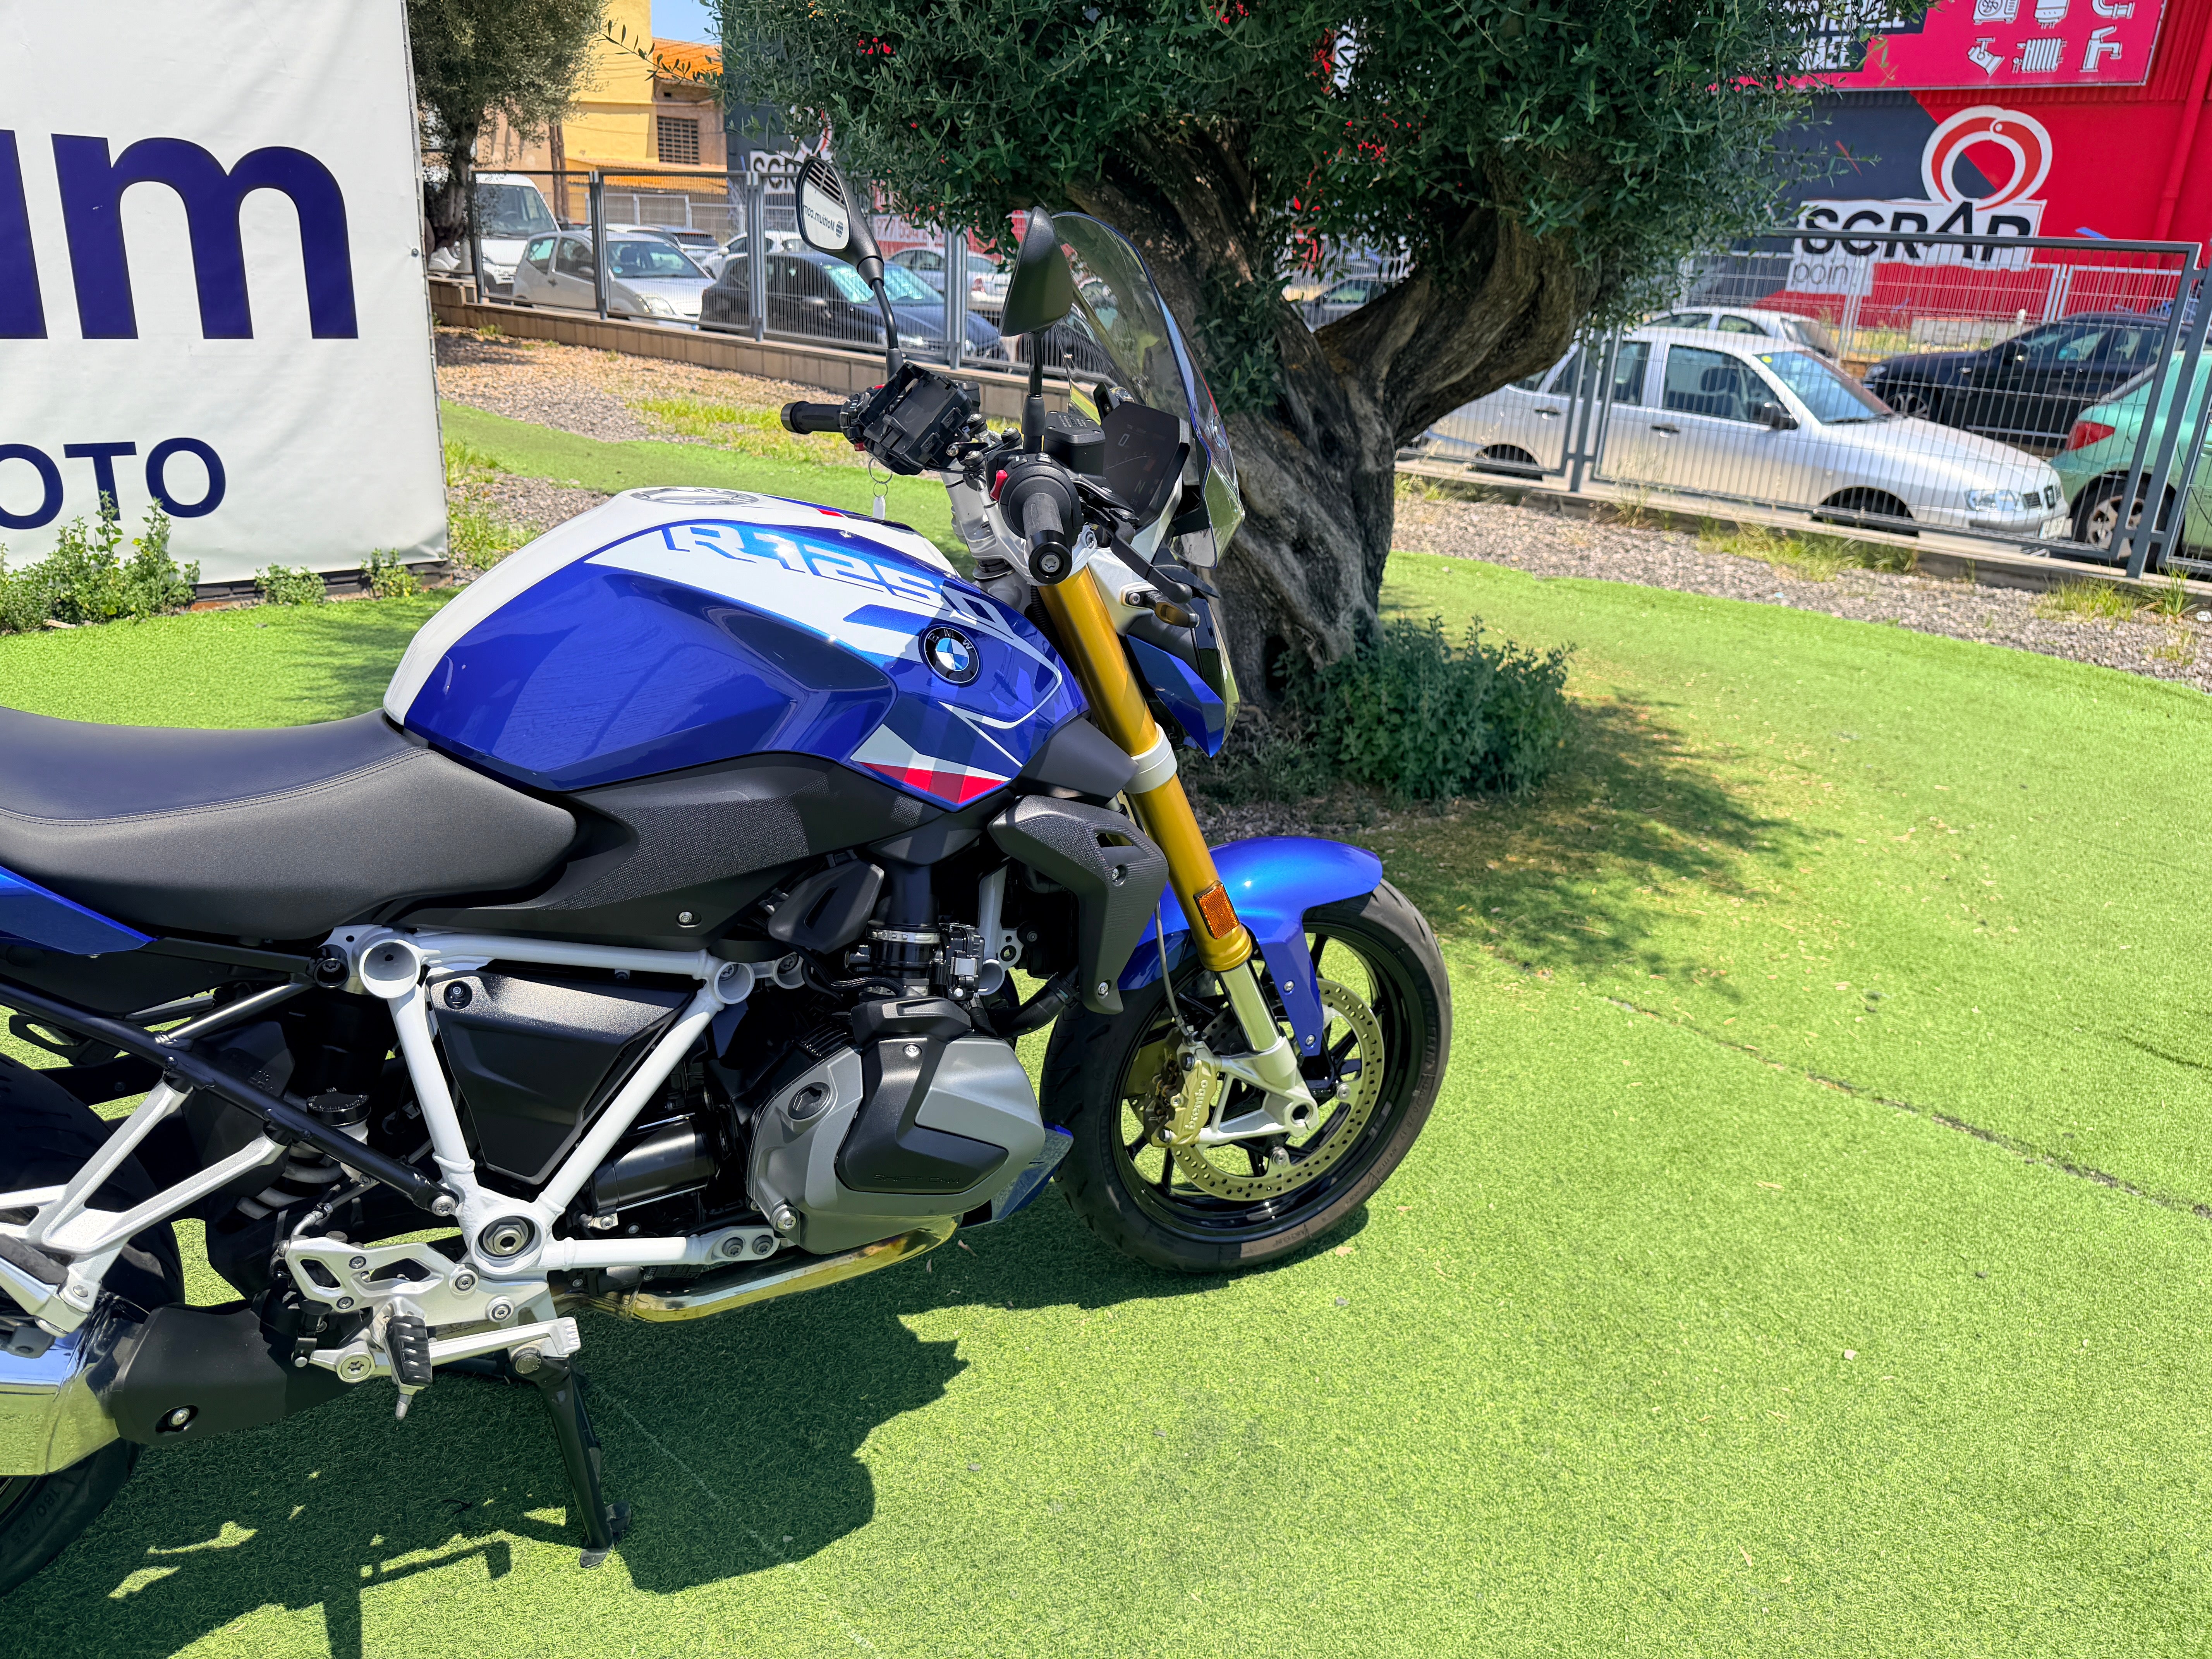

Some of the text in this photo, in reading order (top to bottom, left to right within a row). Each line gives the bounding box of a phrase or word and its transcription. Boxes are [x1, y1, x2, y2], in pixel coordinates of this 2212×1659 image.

[1800, 201, 2031, 262] SCRAP
[1133, 479, 1146, 495] N
[927, 629, 973, 650] BMW
[1184, 1079, 1209, 1130] brembo
[873, 1174, 960, 1184] SHIFT CAM
